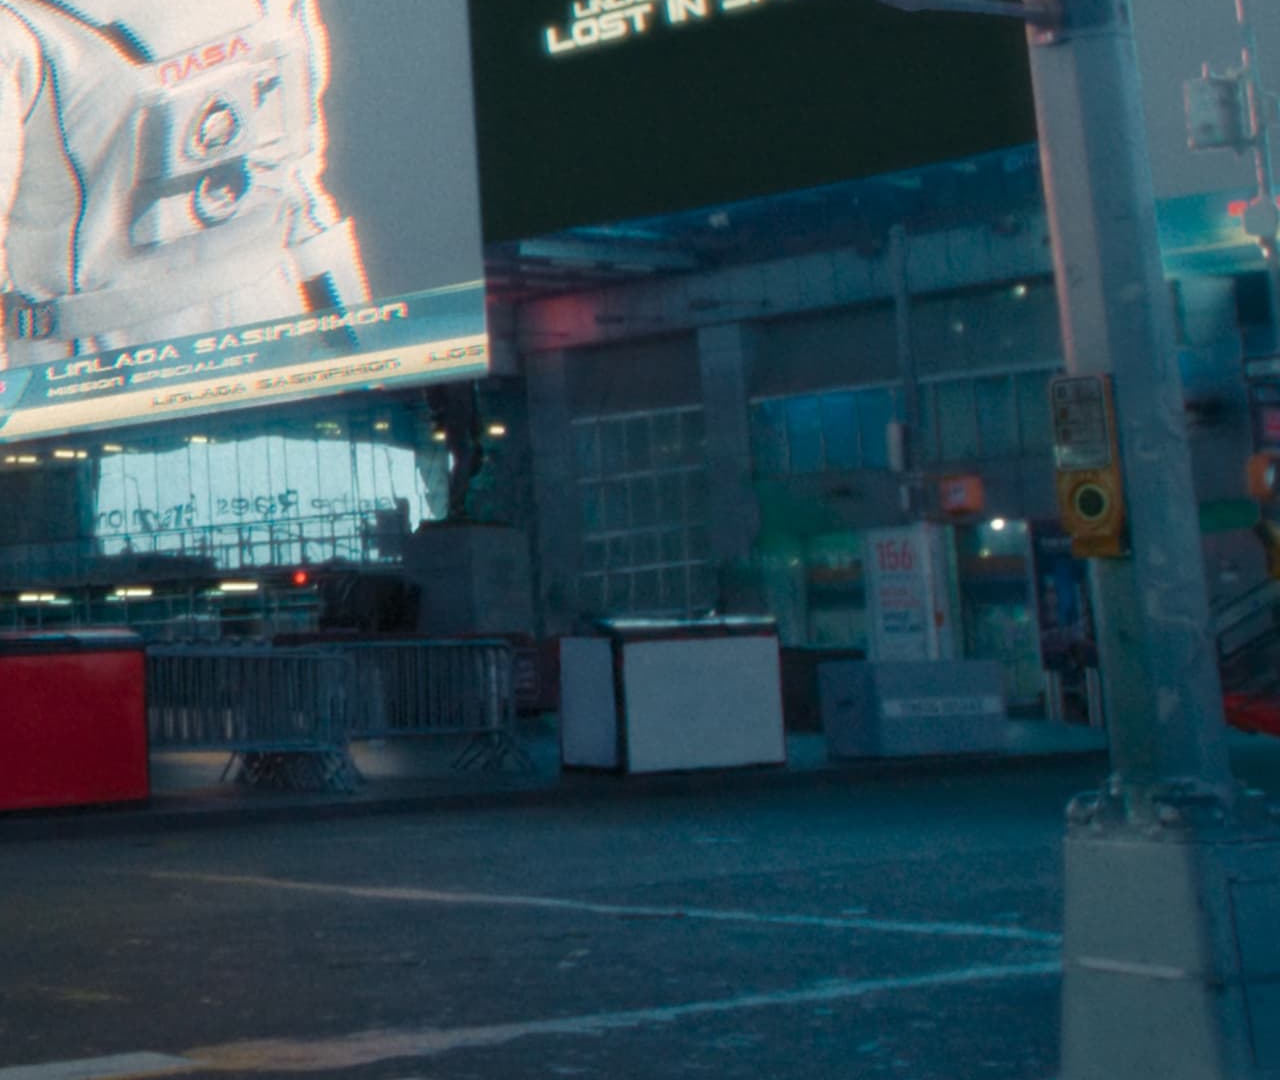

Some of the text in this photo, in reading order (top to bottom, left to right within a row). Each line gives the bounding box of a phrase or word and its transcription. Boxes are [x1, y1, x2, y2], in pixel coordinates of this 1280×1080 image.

[545, 4, 653, 53] LOST
[158, 35, 252, 85] NASA
[46, 302, 408, 380] LINLADA SASINPIMON
